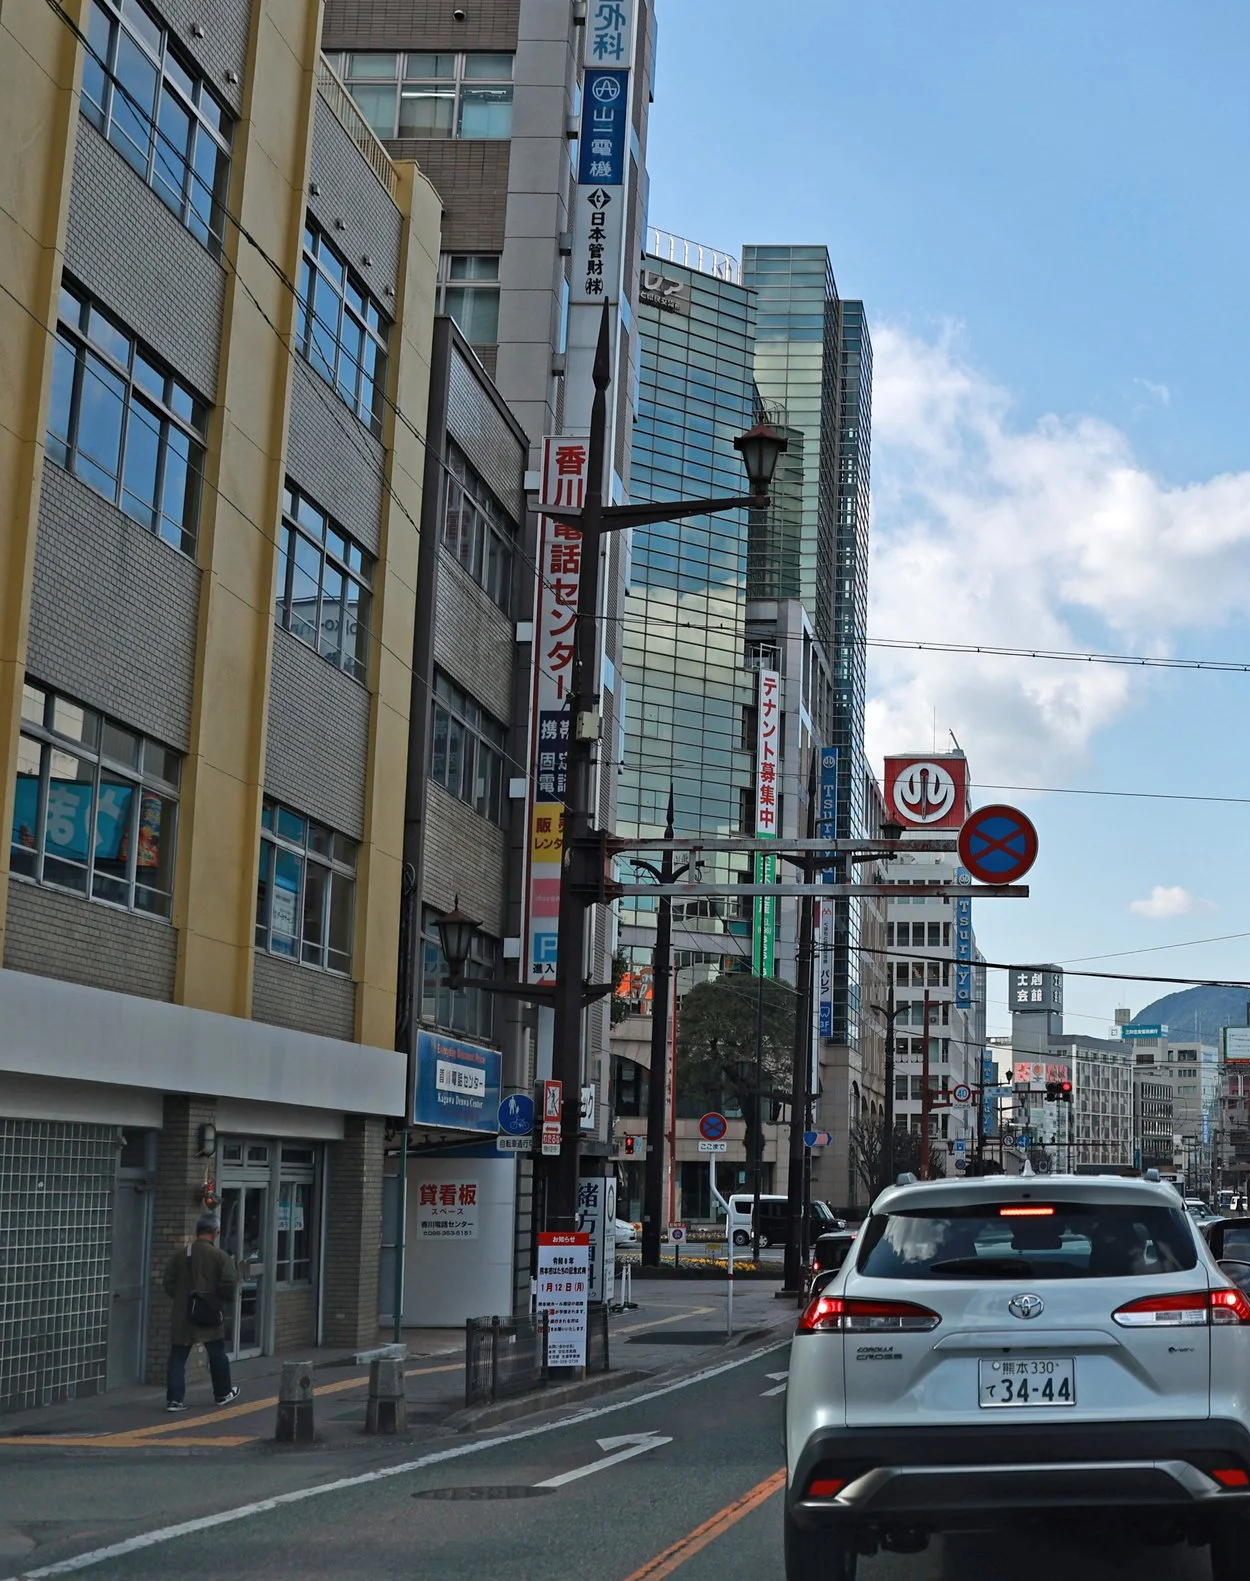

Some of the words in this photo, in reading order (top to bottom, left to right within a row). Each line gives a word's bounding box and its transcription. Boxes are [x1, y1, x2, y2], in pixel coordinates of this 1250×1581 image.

[593, 0, 626, 61] 外科
[589, 106, 614, 178] 山一電機
[759, 676, 777, 829] テナント募集中
[820, 970, 830, 995] パレア
[1016, 988, 1043, 1003] 会館
[957, 1089, 967, 1099] 40
[700, 1143, 726, 1151] ここまで
[419, 1184, 477, 1206] 貸看板
[856, 1353, 903, 1361] CROSS
[985, 1384, 996, 1398] て
[1000, 1377, 1071, 1403] 34-44
